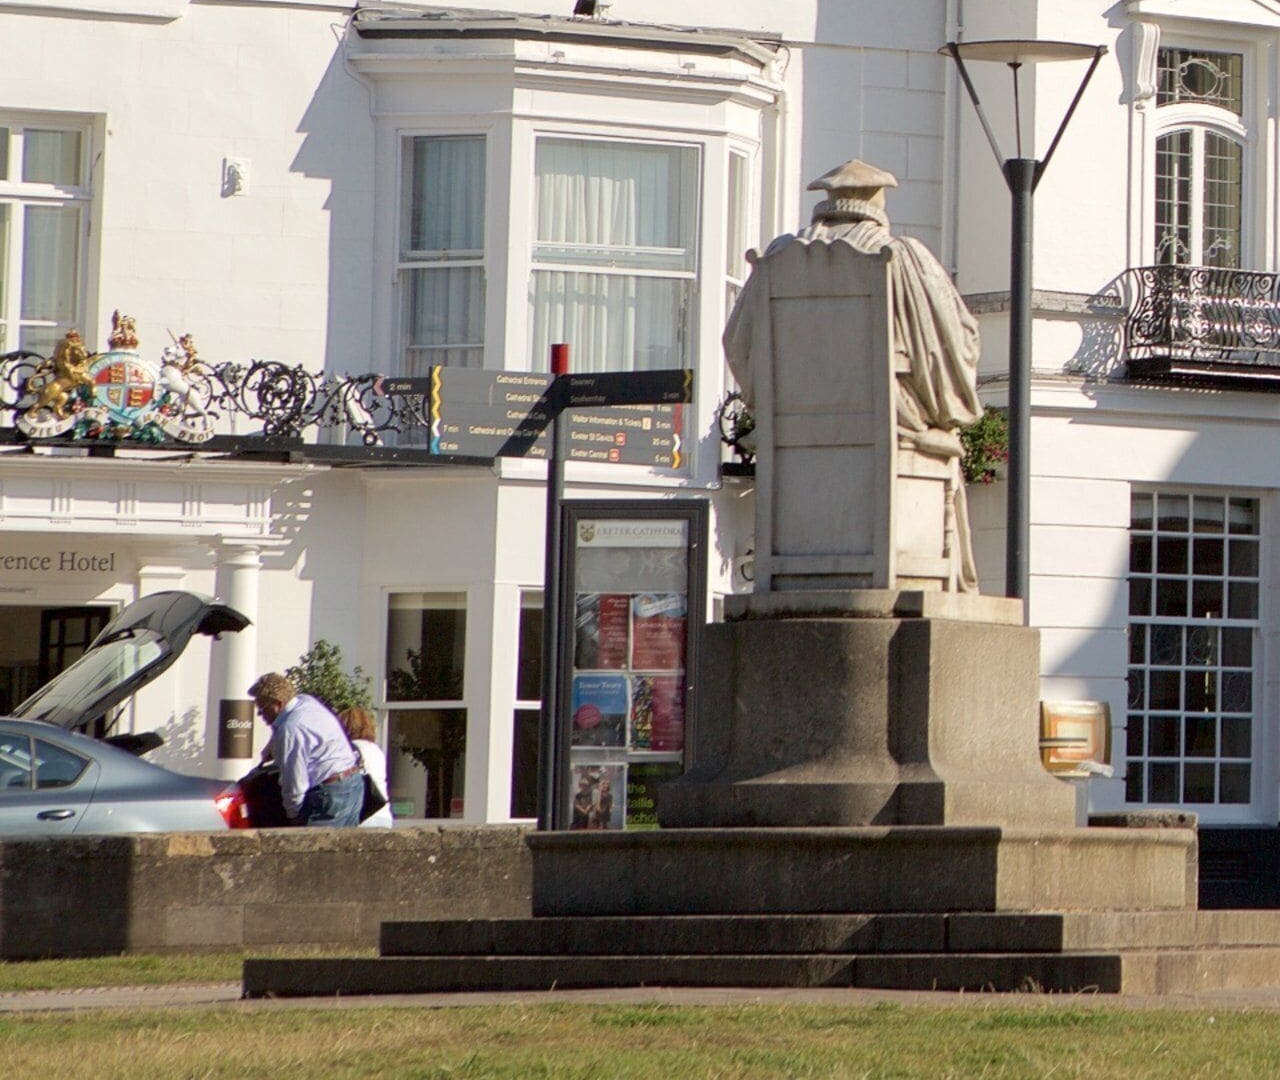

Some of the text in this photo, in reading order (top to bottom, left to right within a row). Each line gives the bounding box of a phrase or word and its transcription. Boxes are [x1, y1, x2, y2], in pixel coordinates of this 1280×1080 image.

[496, 375, 547, 386] Cathedral Entrance
[397, 382, 412, 391] min
[506, 393, 531, 402] Cathedral
[588, 416, 618, 425] Information
[29, 424, 63, 436] DIEU
[178, 429, 215, 442] DROIT
[469, 426, 496, 435] Cathedral
[571, 431, 588, 440] Exeter
[571, 449, 588, 457] Exeter
[58, 551, 115, 572] Hotel
